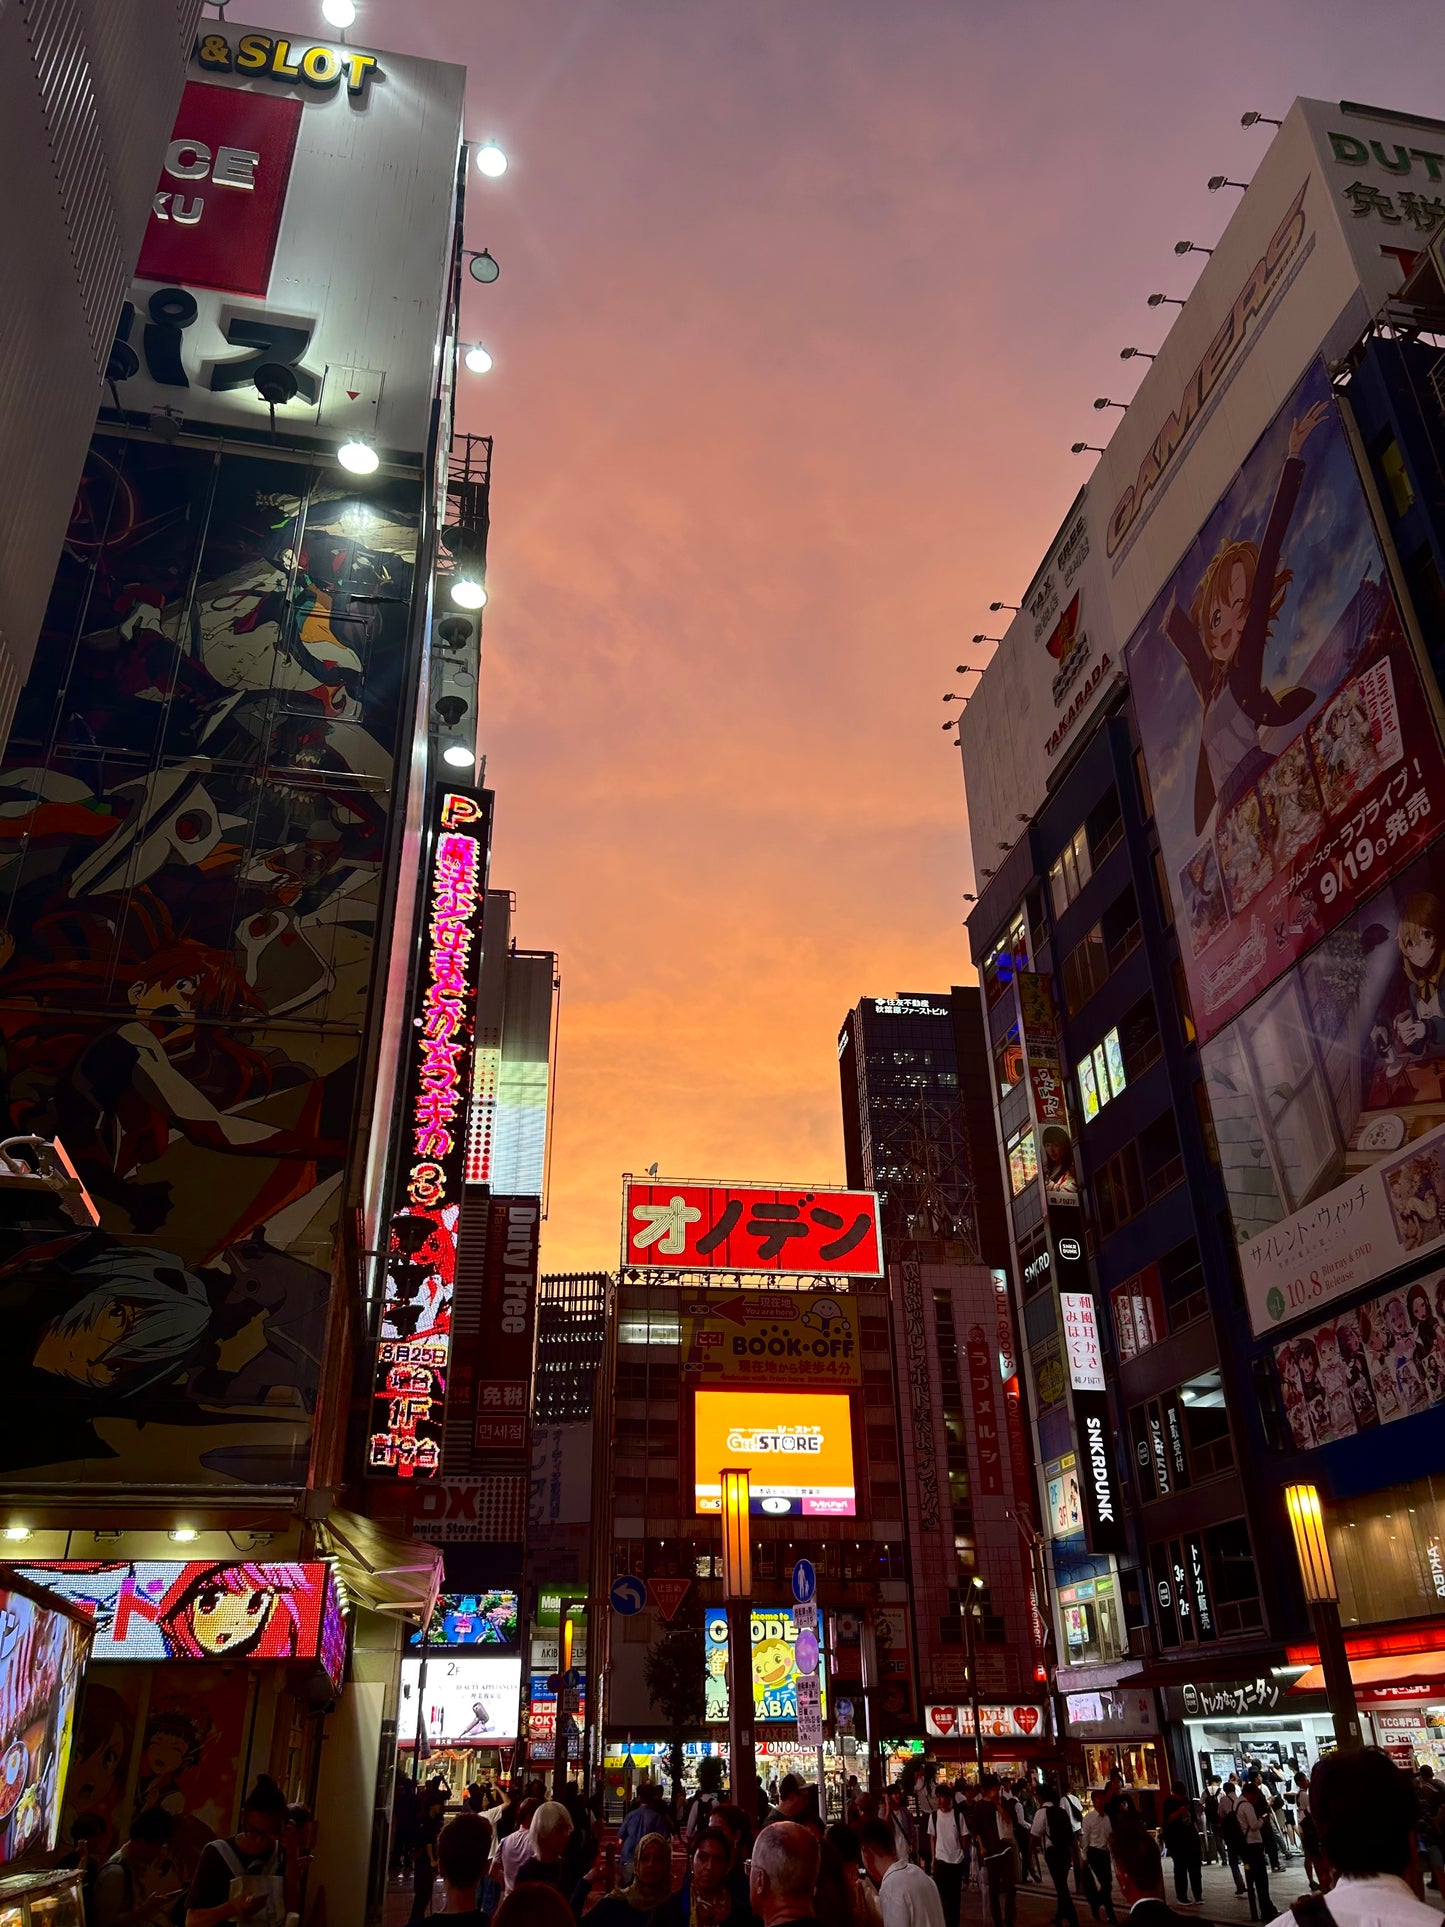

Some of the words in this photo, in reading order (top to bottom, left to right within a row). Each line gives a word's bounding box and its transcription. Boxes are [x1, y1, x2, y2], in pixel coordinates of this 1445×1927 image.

[1106, 174, 1311, 559] GAMERS
[1029, 575, 1053, 618] TAX
[1057, 516, 1086, 571] FREE
[1044, 653, 1113, 757] TAKARADA
[504, 1206, 537, 1266] Duty
[632, 1196, 871, 1261] オノデン
[1250, 1184, 1370, 1270] サイレント・ウィッチ
[502, 1273, 534, 1335] Free
[759, 1296, 793, 1308] 現在地
[993, 1277, 1008, 1318] ADULT
[1286, 1270, 1323, 1308] 10.8
[1324, 1270, 1355, 1290] Release
[777, 1308, 794, 1316] here
[1078, 1296, 1098, 1369] 和風耳かき
[998, 1320, 1014, 1370] GOODS
[482, 1386, 524, 1407] 免税
[971, 1351, 998, 1489] ラブメルシー
[1006, 1391, 1021, 1430] LOVE
[1010, 1430, 1026, 1477] MERCI
[1085, 1416, 1114, 1523] SNKRDUNK
[446, 1523, 477, 1534] Store
[658, 1583, 682, 1592] 止まれ
[1381, 1717, 1421, 1728] TCG専門店
